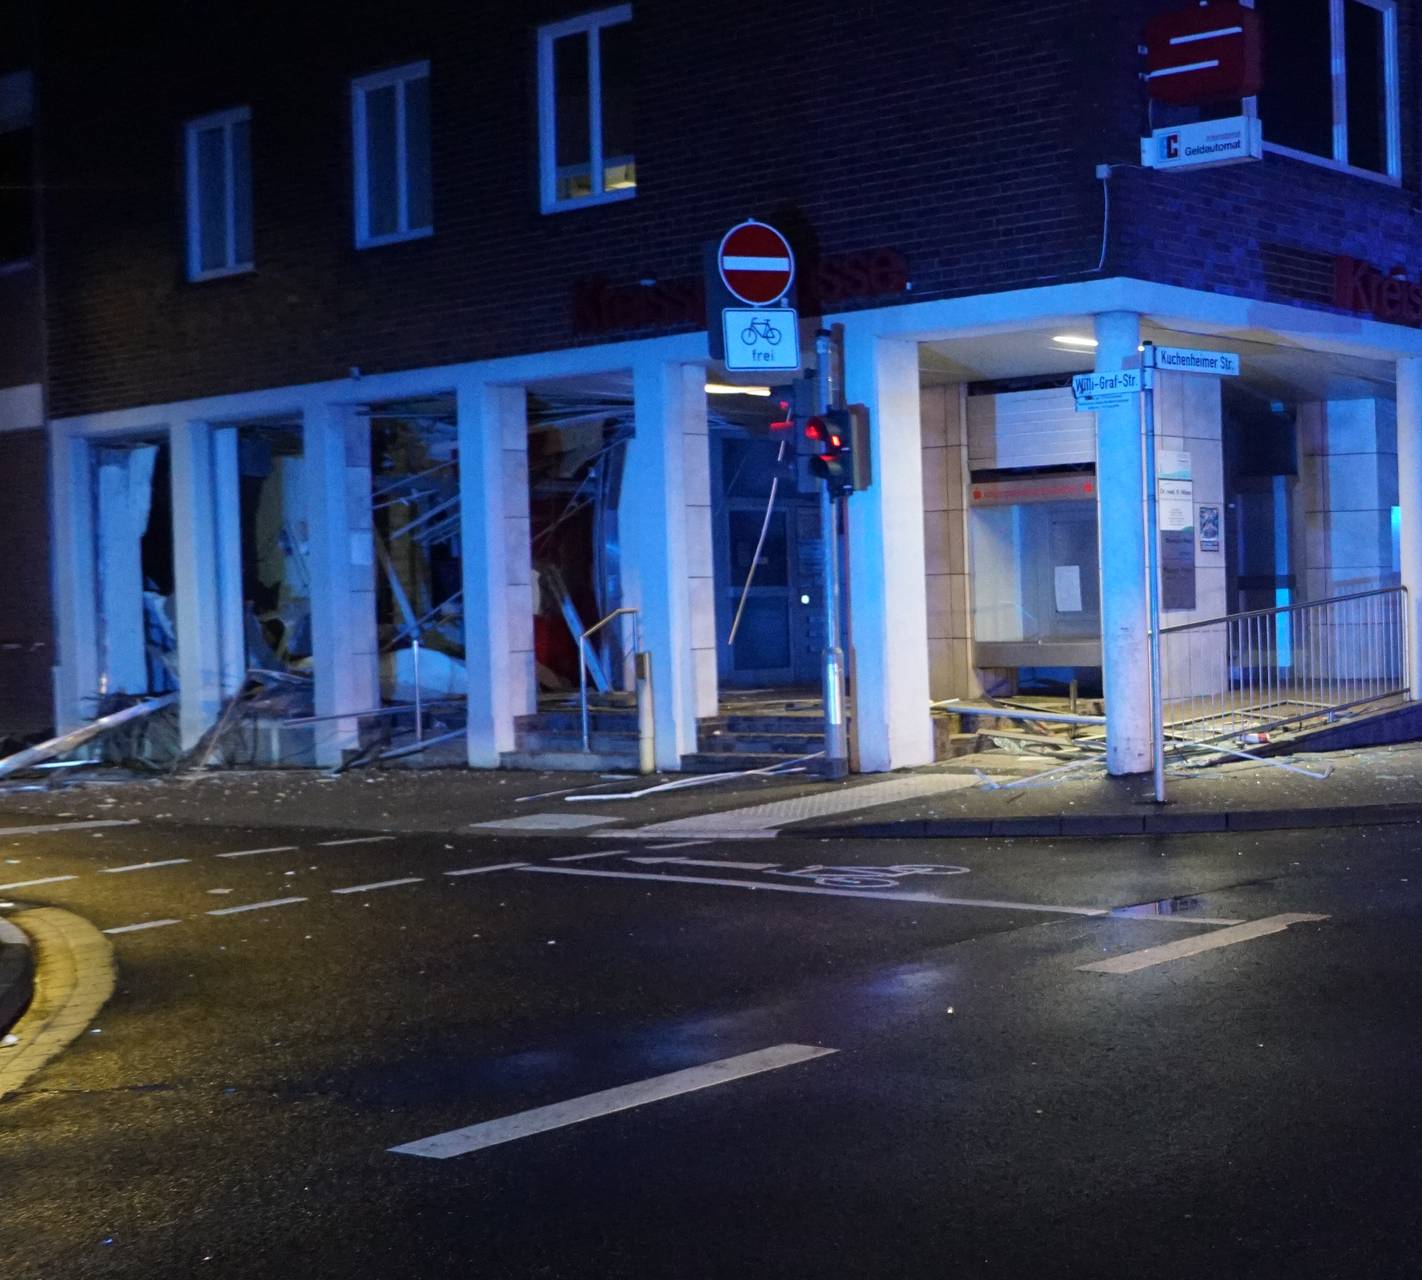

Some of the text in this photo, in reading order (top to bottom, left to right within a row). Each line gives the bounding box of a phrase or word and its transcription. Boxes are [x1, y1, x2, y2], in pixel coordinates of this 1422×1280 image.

[1184, 139, 1241, 157] Geldautomat
[752, 348, 776, 363] frei
[1160, 353, 1235, 370] Kuchenheimer Str.
[1075, 375, 1138, 394] Willi-Graf-Str.
